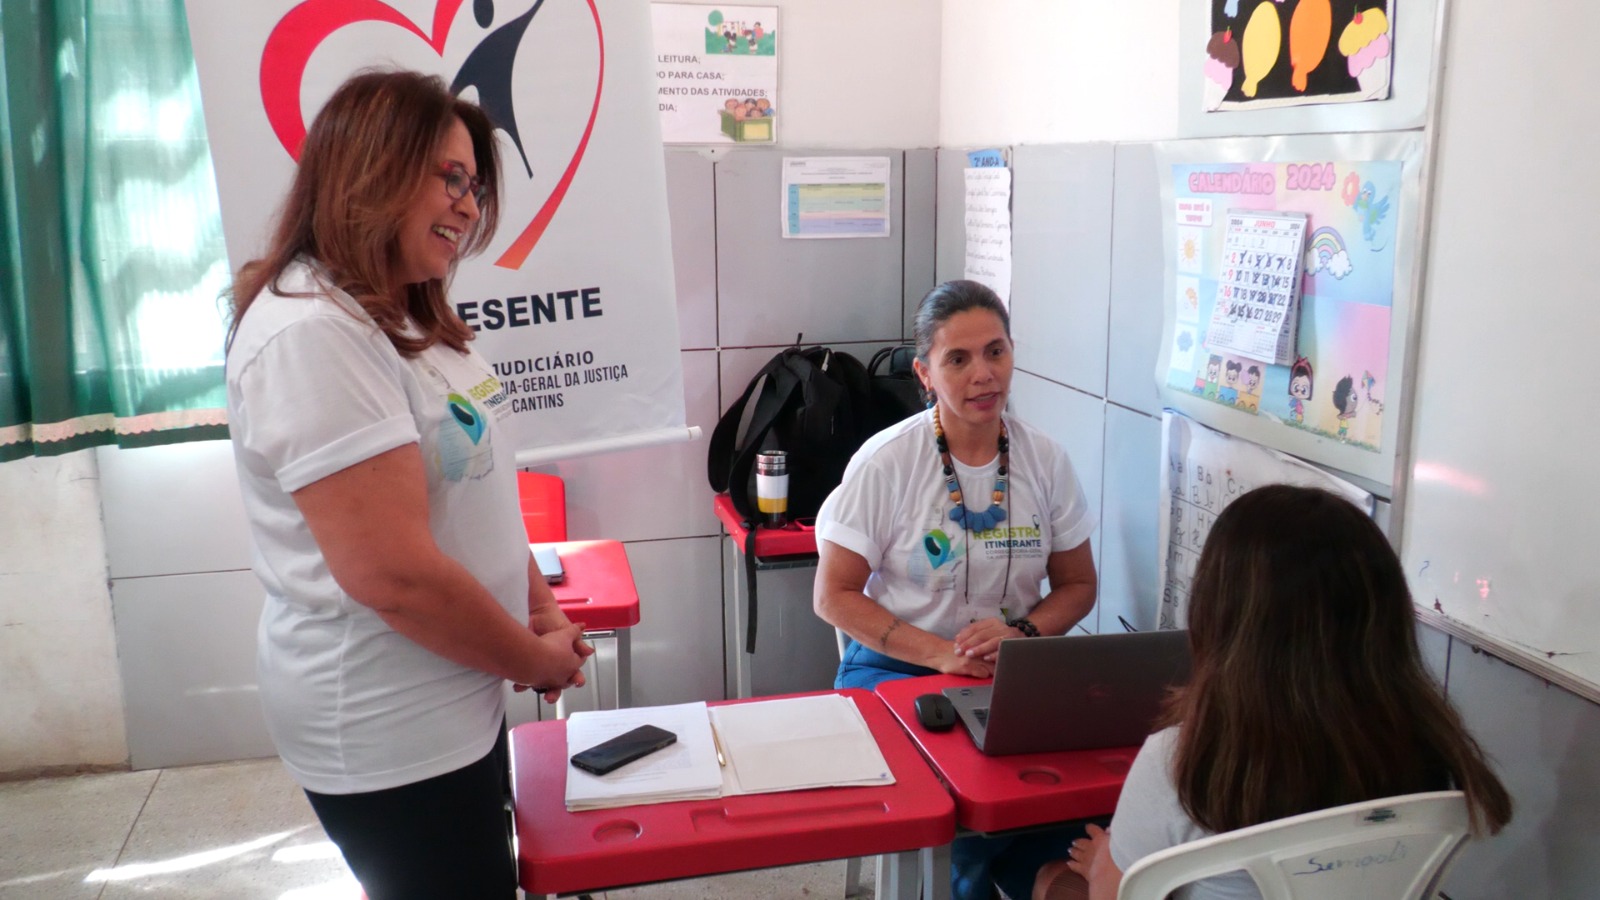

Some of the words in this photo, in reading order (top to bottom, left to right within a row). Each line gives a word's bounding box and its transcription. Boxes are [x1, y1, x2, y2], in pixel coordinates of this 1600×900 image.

[658, 54, 701, 65] LEITURA;
[656, 71, 666, 80] O
[668, 70, 695, 80] PARA
[696, 72, 725, 81] CASA;
[690, 87, 710, 96] DAS
[711, 88, 768, 98] ATIVIDADES;
[658, 103, 678, 113] DIA;
[1189, 168, 1275, 195] CALENDÁRIO
[1287, 163, 1336, 190] 2024
[1231, 251, 1237, 264] 2
[1228, 269, 1234, 281] 9
[1224, 285, 1232, 298] 16
[1253, 307, 1265, 320] 27
[492, 351, 594, 376] JUDICIÁRIO
[564, 371, 581, 387] DA
[583, 364, 629, 385] JUSTIÇA
[985, 540, 1041, 549] ITINERANTE
